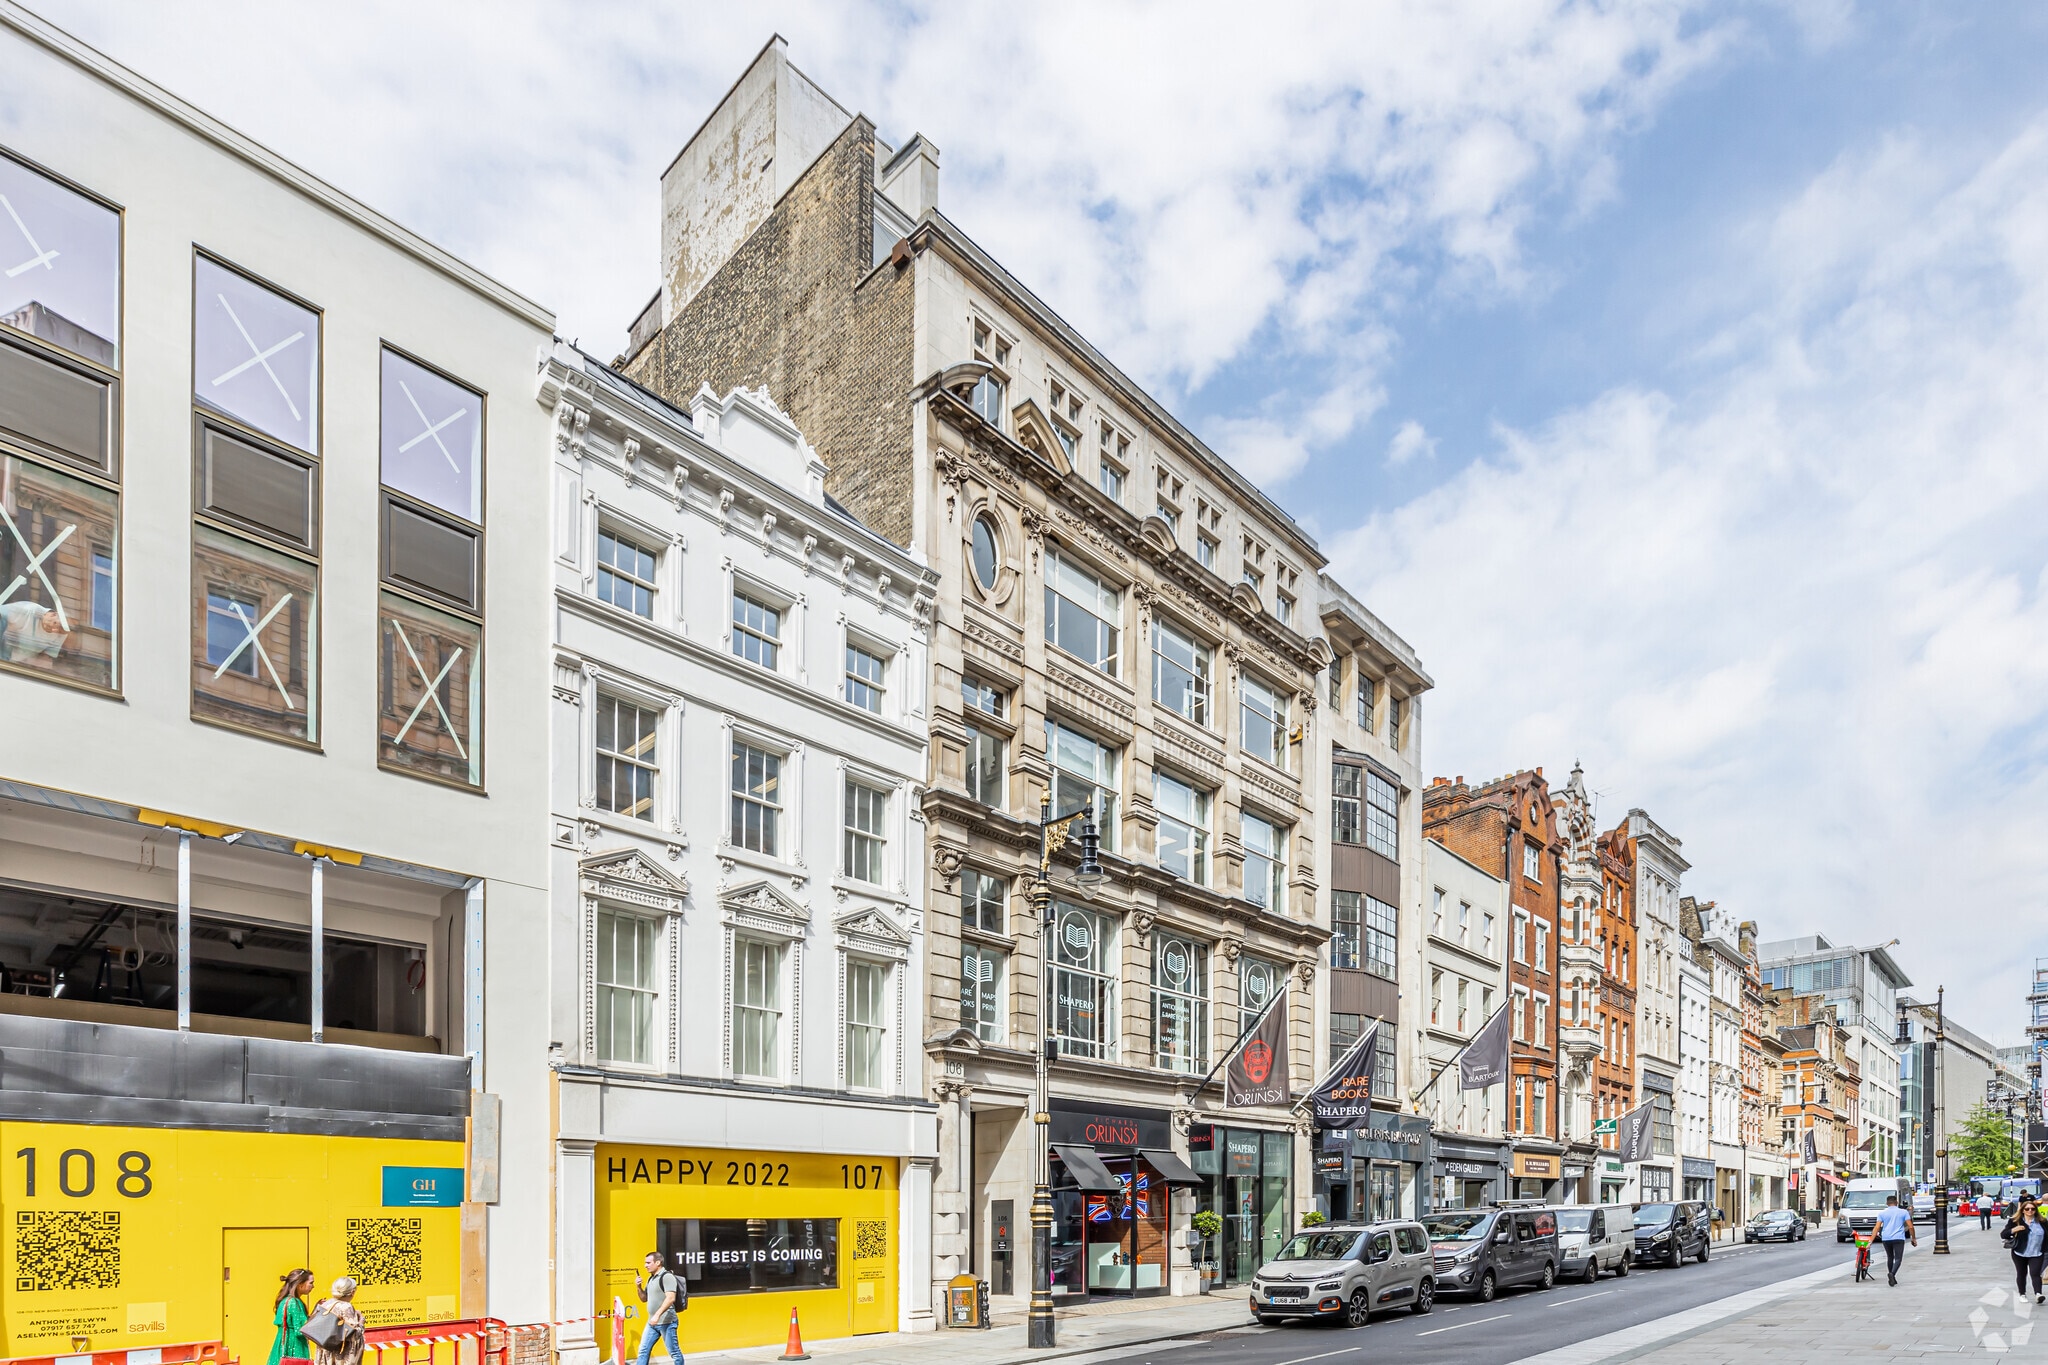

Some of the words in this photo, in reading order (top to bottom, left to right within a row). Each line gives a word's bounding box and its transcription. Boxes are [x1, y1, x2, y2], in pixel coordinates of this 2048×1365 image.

[960, 988, 973, 997] ARE
[1059, 994, 1094, 1010] SHAPERO
[945, 1061, 962, 1075] 106
[1342, 1075, 1369, 1087] RARE
[1331, 1088, 1369, 1100] BOOKS
[1316, 1105, 1367, 1116] SHAPERO
[1631, 1118, 1641, 1160] Bonhams
[1228, 1142, 1257, 1154] SHAPERO
[17, 1148, 152, 1198] 108
[608, 1157, 713, 1185] HAPPY
[727, 1161, 790, 1186] 2022
[1450, 1162, 1463, 1173] EDEN
[1463, 1163, 1483, 1174] GALLERY
[841, 1164, 883, 1189] 107
[412, 1178, 436, 1191] GH
[676, 1252, 706, 1264] THE
[711, 1250, 748, 1264] BEST
[753, 1250, 767, 1262] IS
[771, 1248, 823, 1261] COMING
[29, 1318, 70, 1326] ANTHONY
[428, 1311, 455, 1321] savills
[129, 1321, 165, 1333] savills
